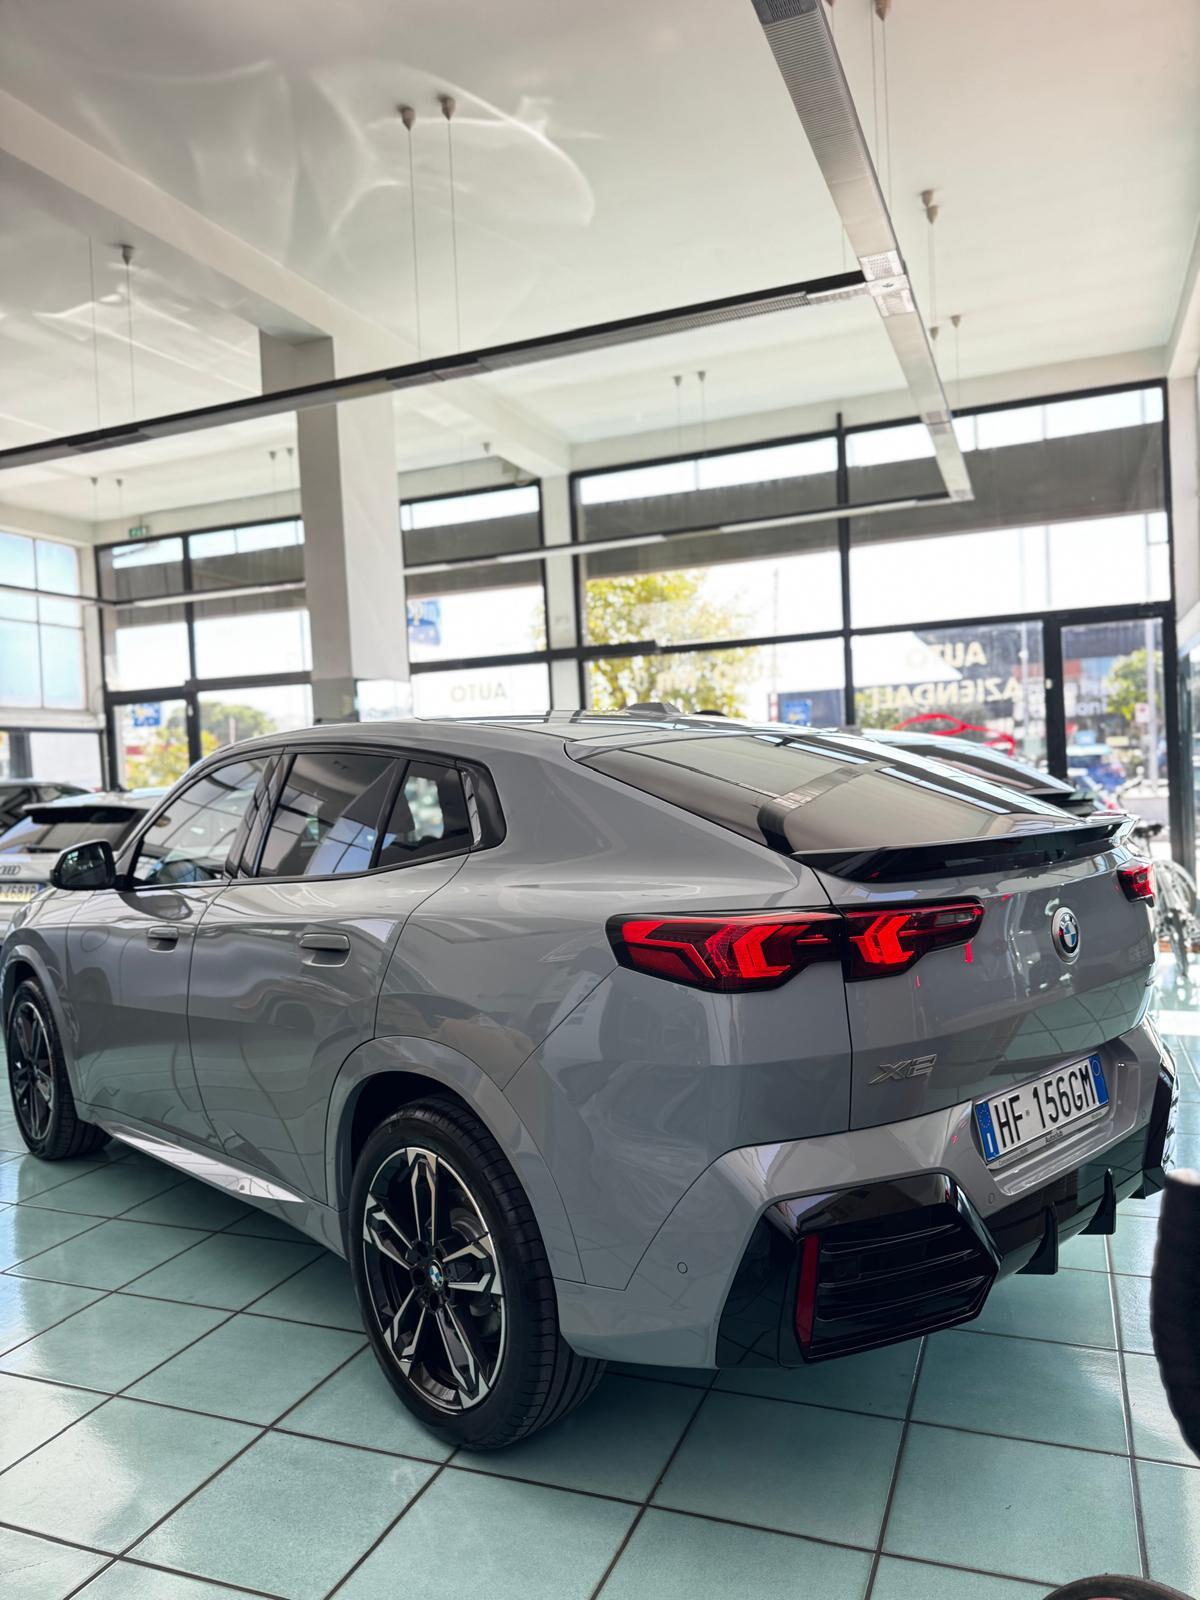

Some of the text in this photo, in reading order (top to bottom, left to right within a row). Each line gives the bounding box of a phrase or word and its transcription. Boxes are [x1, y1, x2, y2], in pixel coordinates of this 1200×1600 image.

[869, 1053, 937, 1085] X2
[993, 1094, 1023, 1148] HF
[1032, 1064, 1096, 1129] 156GM
